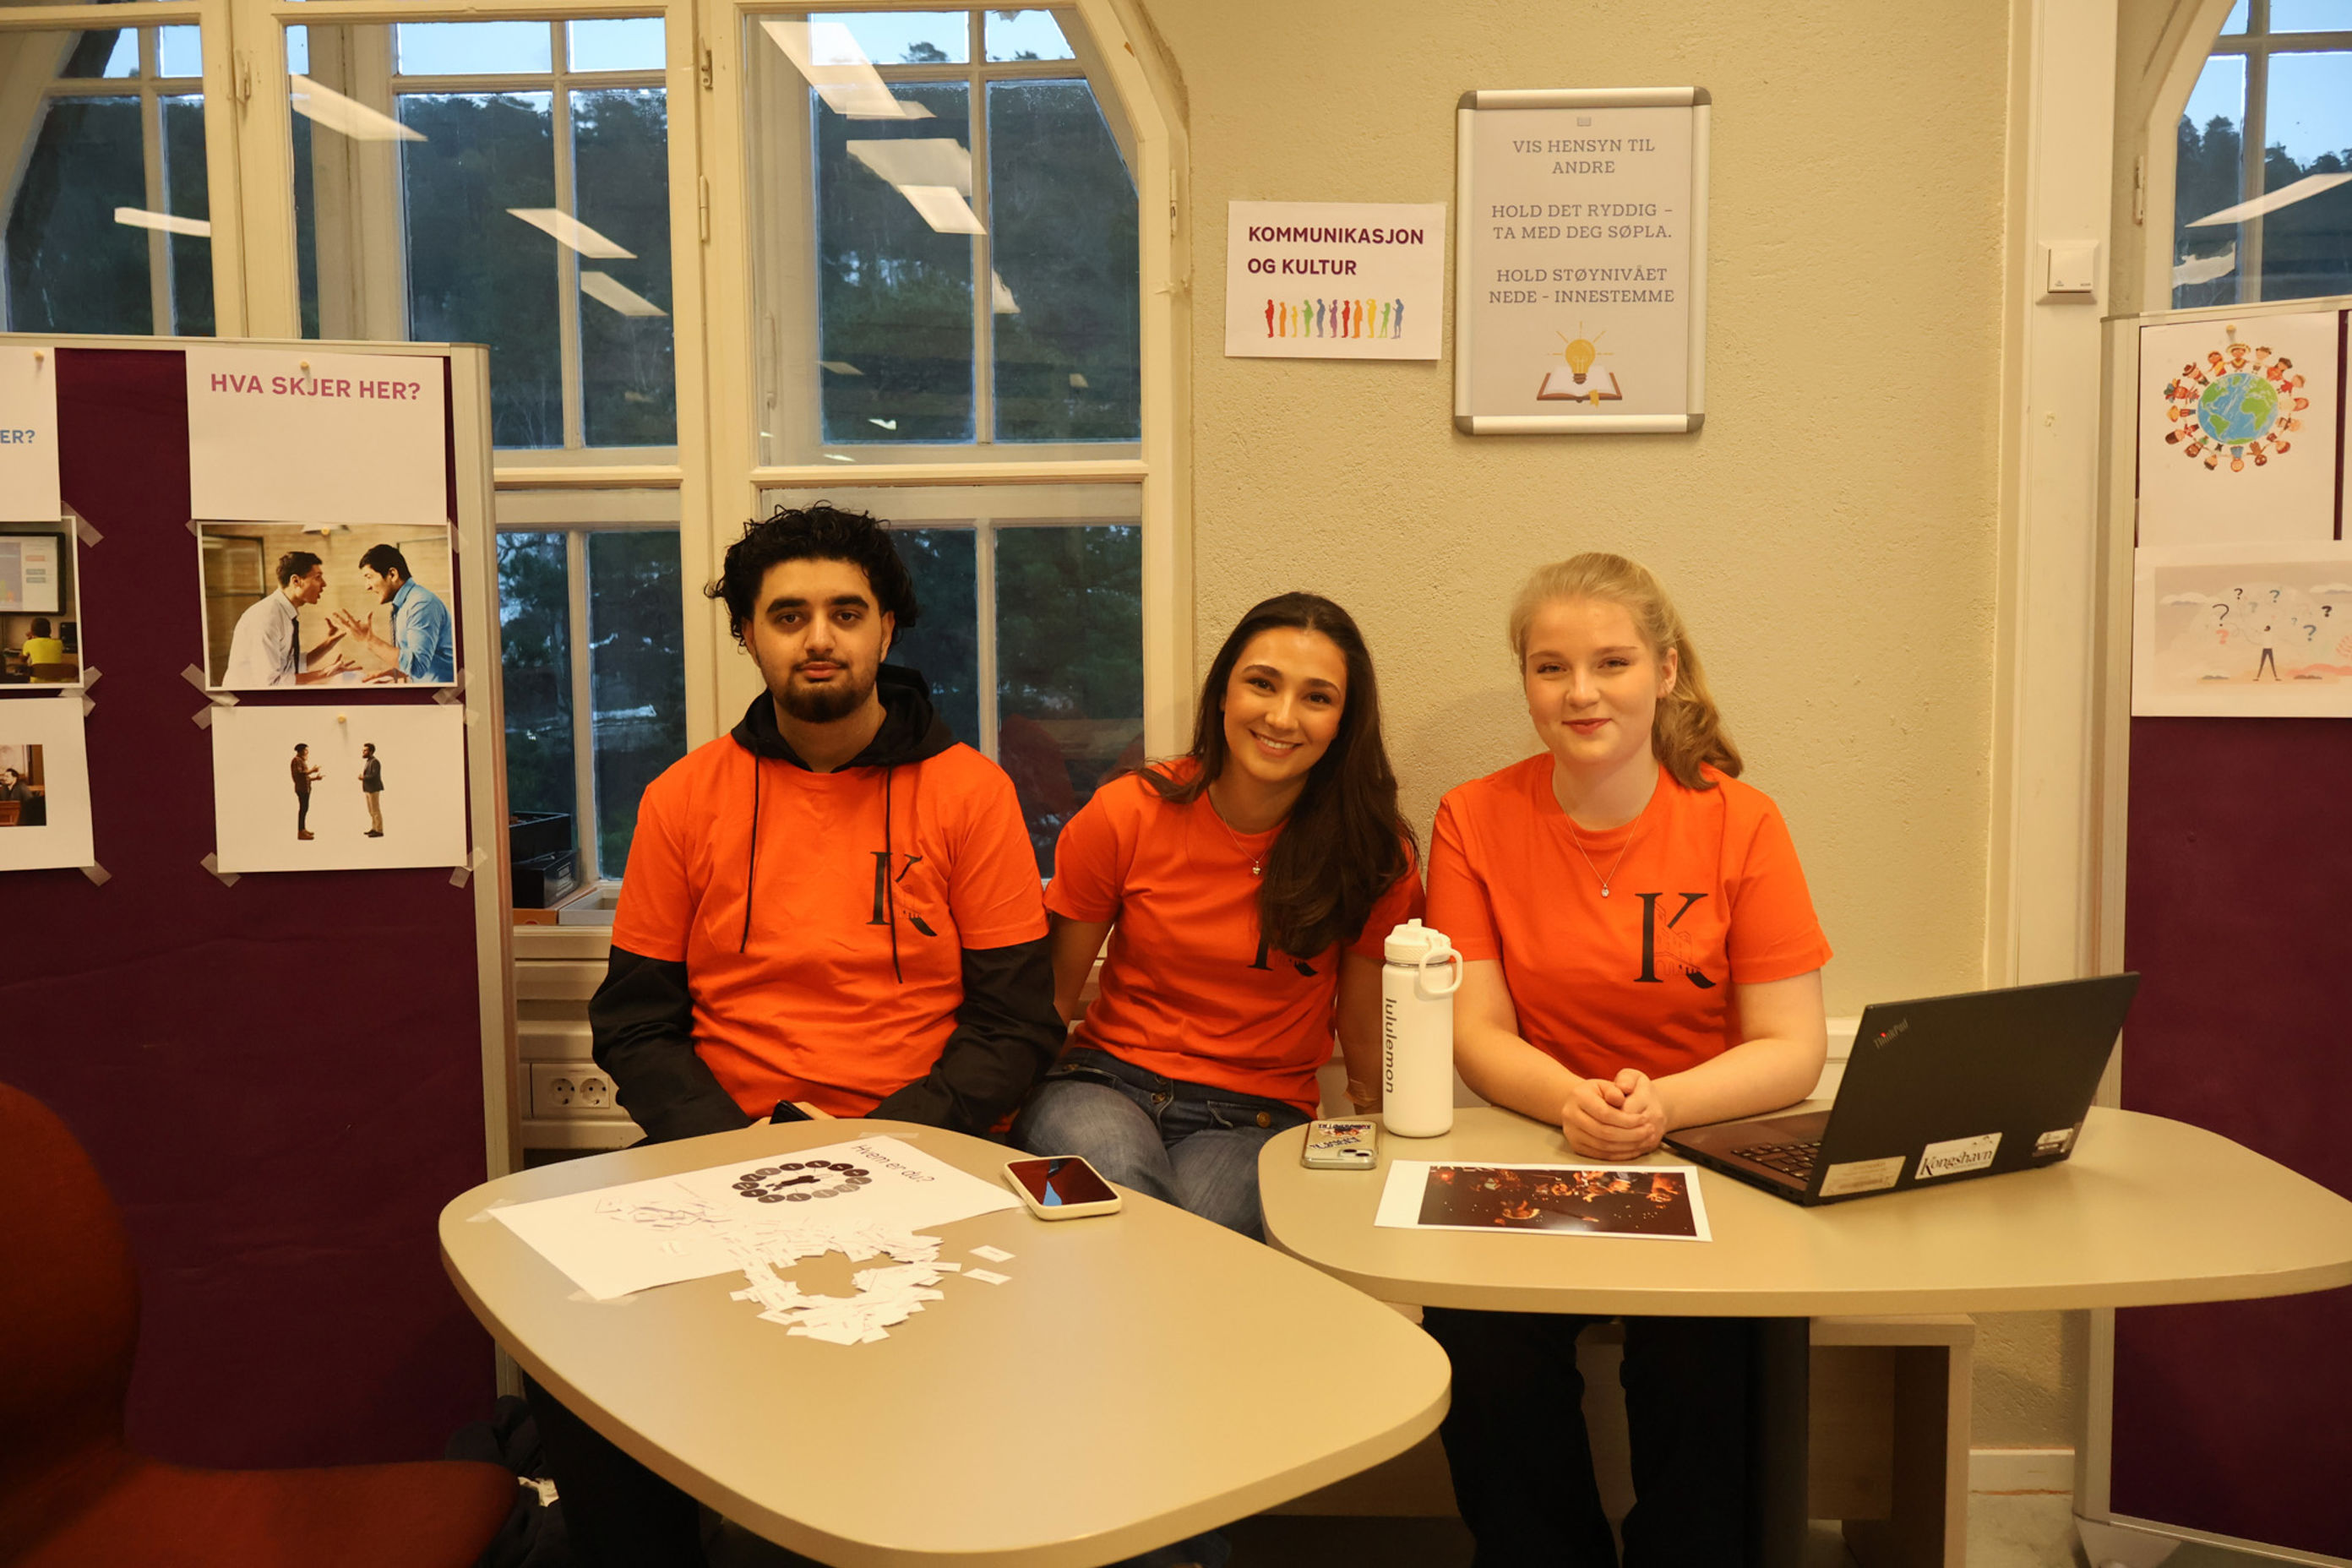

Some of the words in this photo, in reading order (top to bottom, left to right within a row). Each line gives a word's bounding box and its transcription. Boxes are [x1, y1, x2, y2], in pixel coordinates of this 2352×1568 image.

[1512, 140, 1542, 153] VIS
[1548, 139, 1622, 153] HENSYN
[1627, 139, 1655, 151] TIL
[1552, 161, 1615, 174] ANDRE
[1491, 204, 1543, 218] HOLD
[1548, 204, 1582, 217] DET
[1587, 204, 1657, 217] RYDDIG
[1249, 226, 1424, 245] KOMMUNIKASJON
[1493, 226, 1516, 239] TA
[1522, 226, 1561, 238] MED
[1566, 226, 1603, 238] DEG
[1608, 225, 1672, 239] SØPLA.
[1247, 258, 1277, 274] OG
[1282, 259, 1357, 275] KULTUR
[1497, 269, 1548, 282] HOLD
[1553, 264, 1668, 282] STØYNIVÅET
[1489, 291, 1538, 303] NEDE
[1554, 290, 1674, 302] INNESTEMME
[210, 373, 264, 394] HVA
[271, 376, 351, 398] SKJER
[359, 380, 421, 400] HER?
[0, 429, 35, 444] ER?
[1633, 892, 1716, 989] K
[1386, 998, 1397, 1093] lululemon
[851, 1144, 890, 1163] Hvem
[1920, 1151, 1993, 1175] Kongshavn
